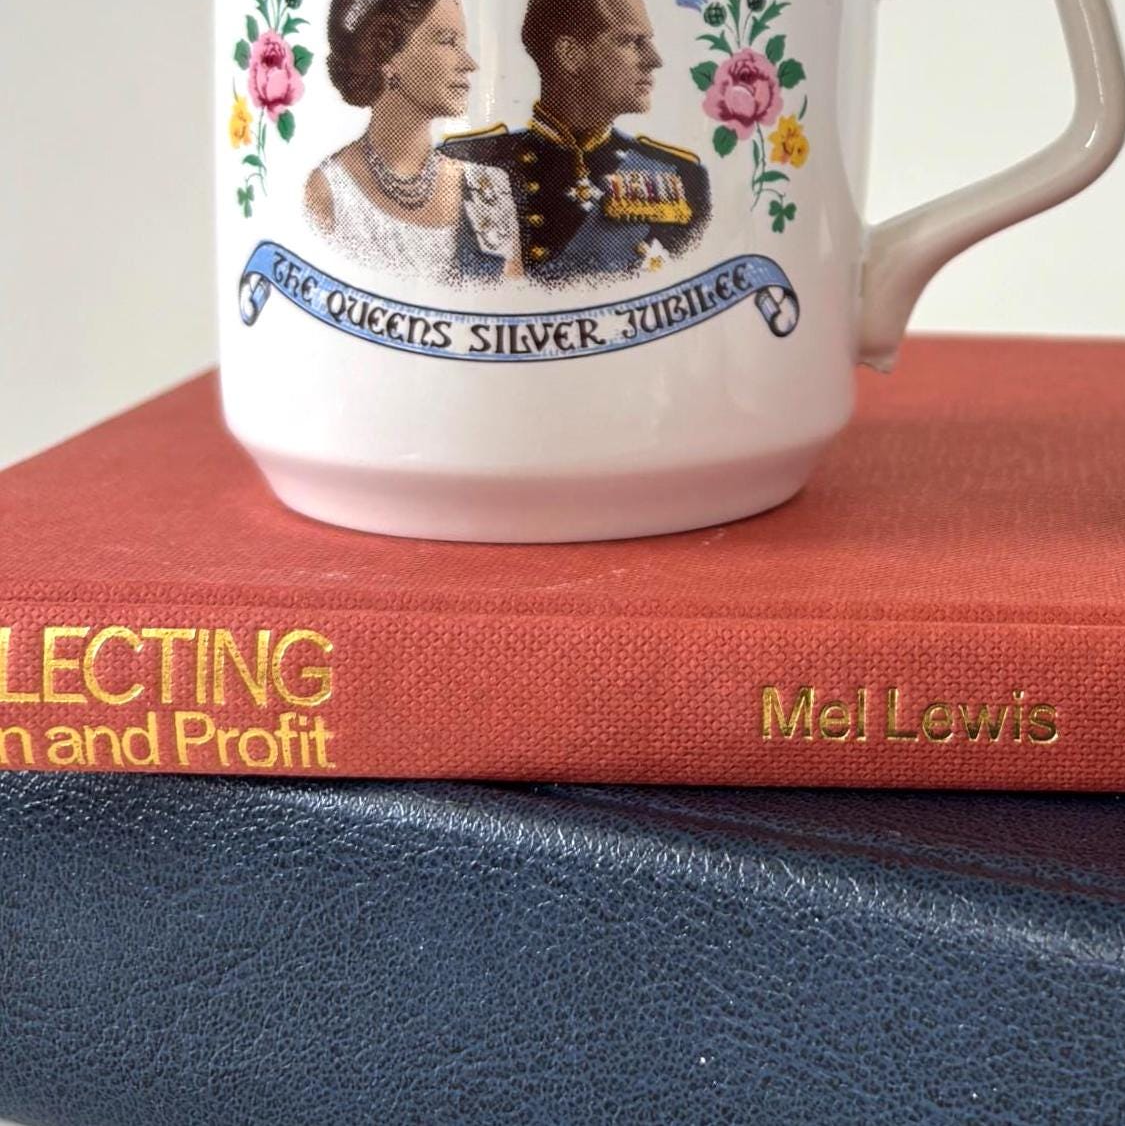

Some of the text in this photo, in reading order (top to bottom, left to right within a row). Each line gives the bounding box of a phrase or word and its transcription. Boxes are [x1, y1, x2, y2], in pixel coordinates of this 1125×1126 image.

[326, 289, 452, 349] QUEENS
[468, 318, 607, 354] SILVER
[614, 262, 754, 339] JUBILEE
[0, 626, 334, 708] LECTING
[45, 711, 161, 767] and
[174, 711, 336, 768] Profit
[761, 686, 1060, 745] Mel Lewis
